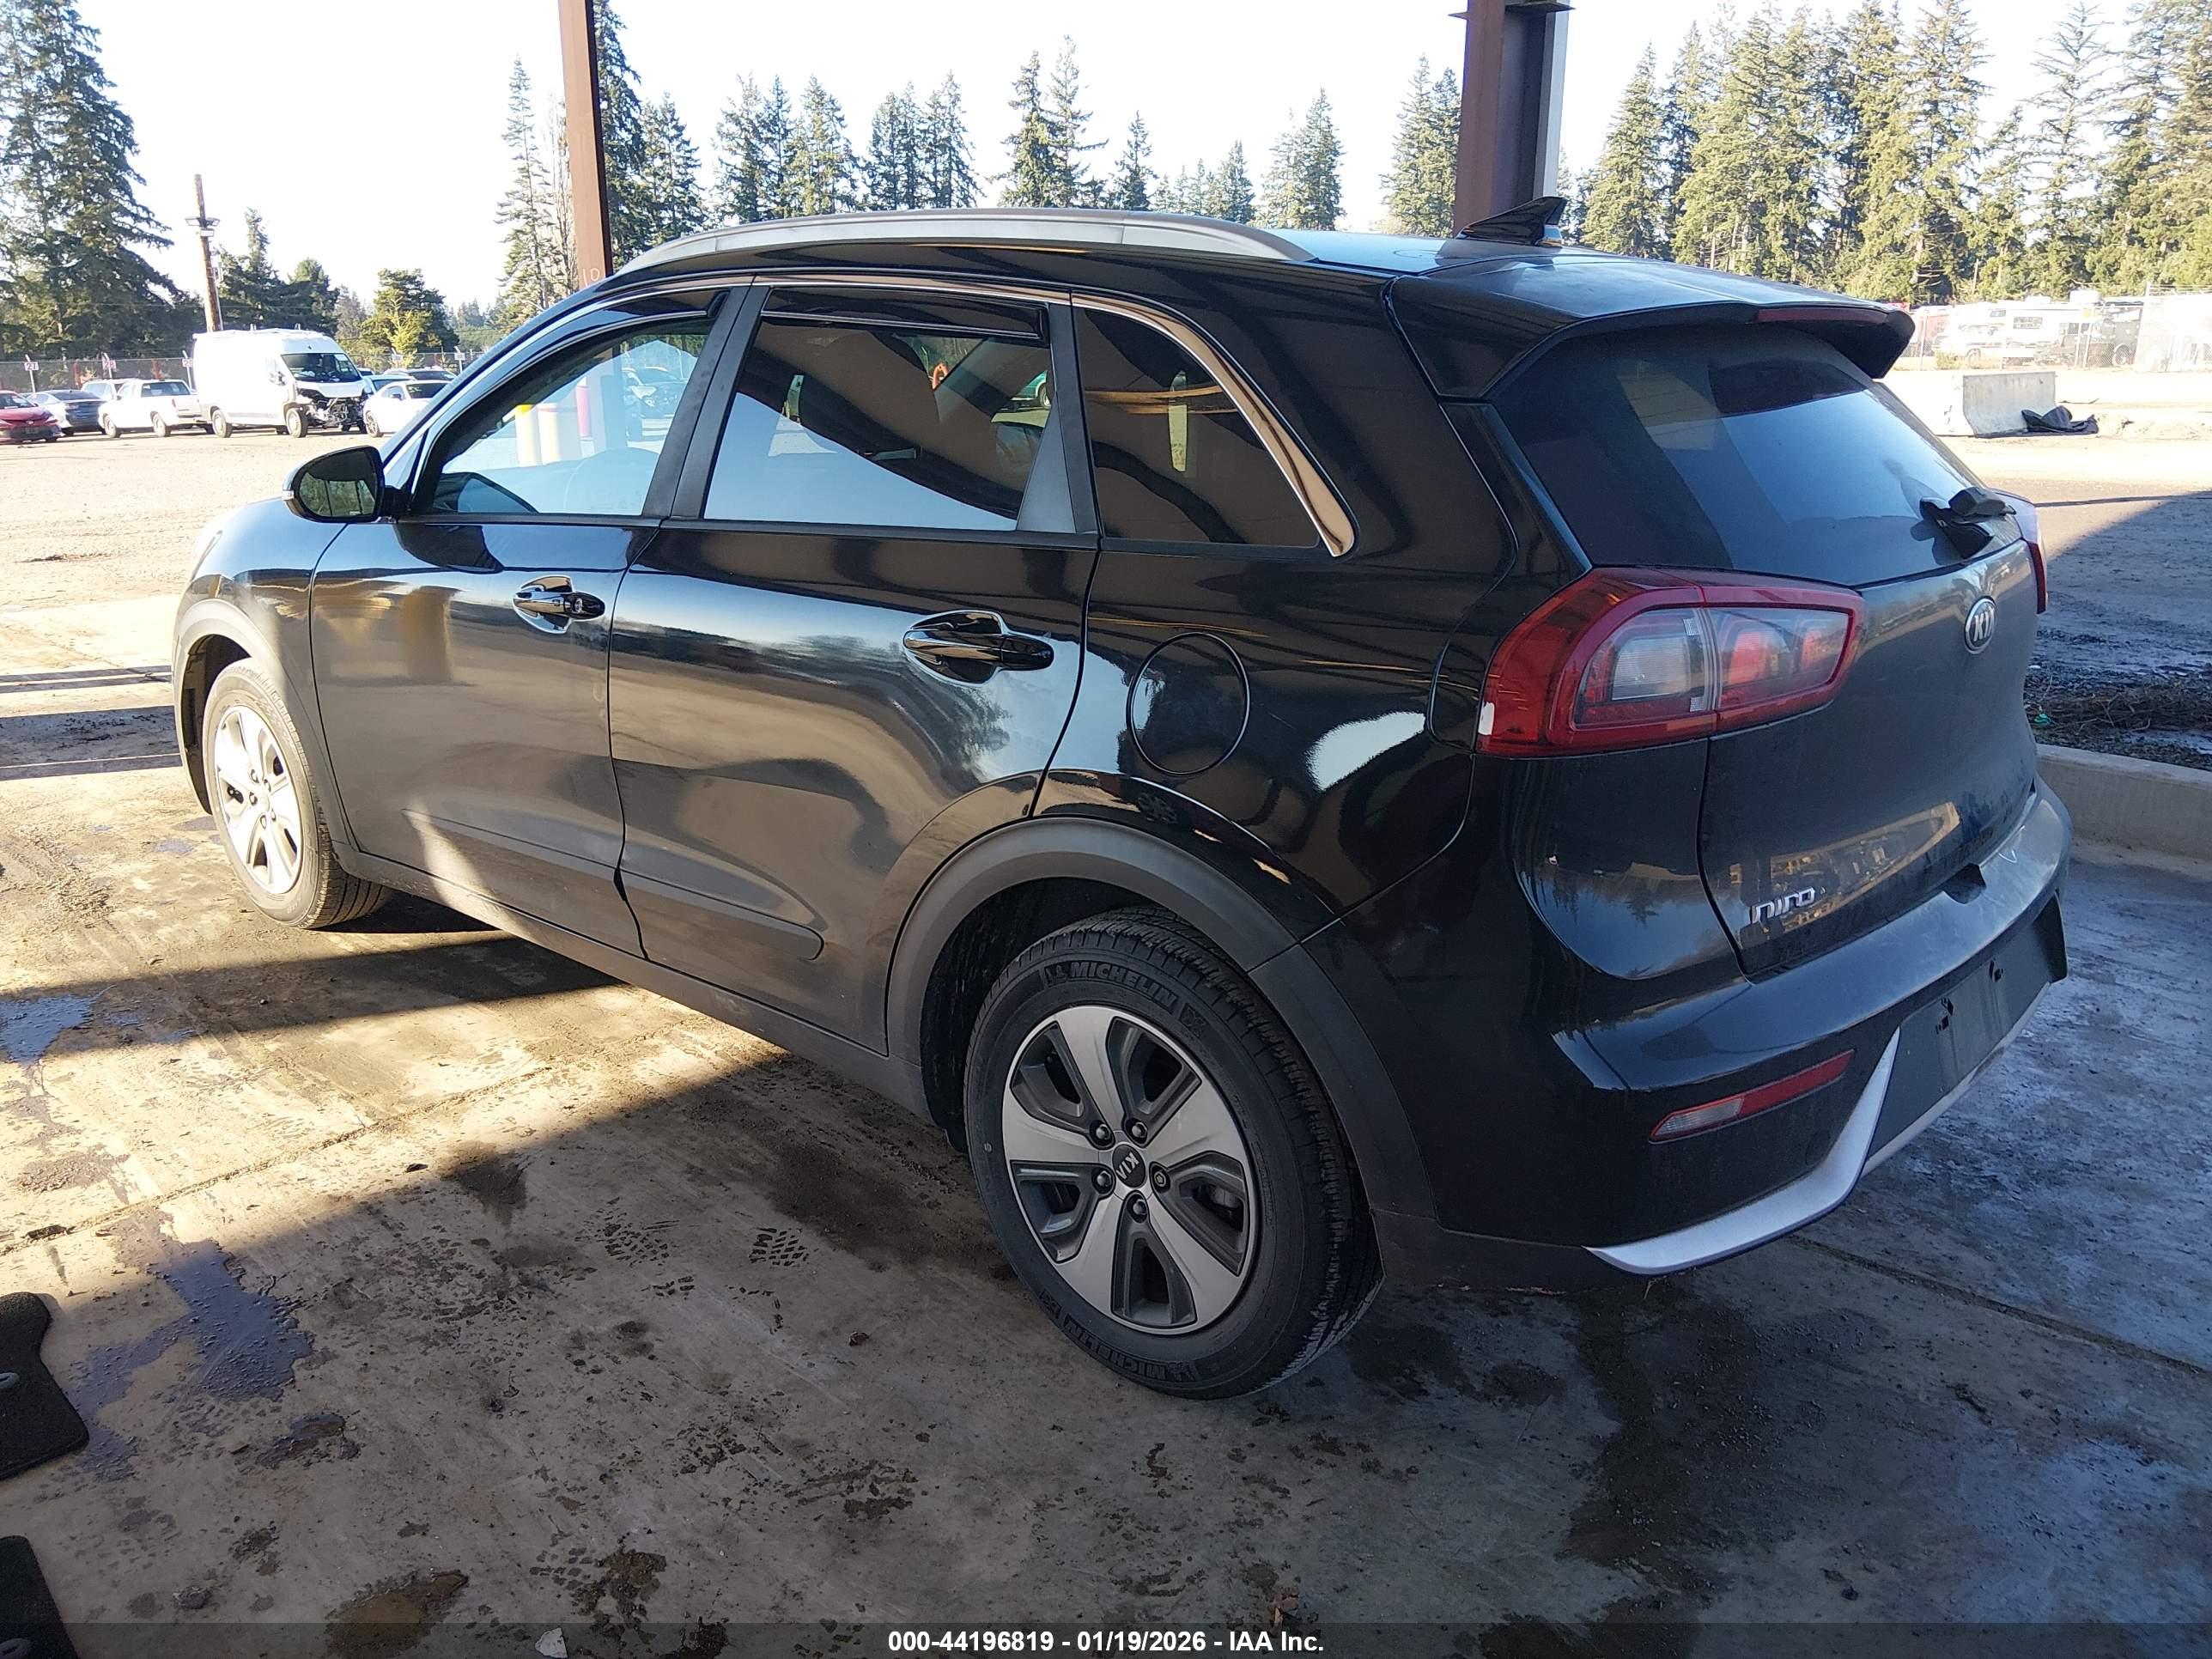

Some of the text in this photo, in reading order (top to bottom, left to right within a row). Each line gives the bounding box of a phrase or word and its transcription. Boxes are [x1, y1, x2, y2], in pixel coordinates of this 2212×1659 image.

[582, 267, 601, 288] 10
[1973, 604, 1995, 642] KIA
[1071, 961, 1180, 1014] MICHELIN
[1115, 1152, 1140, 1180] KIA
